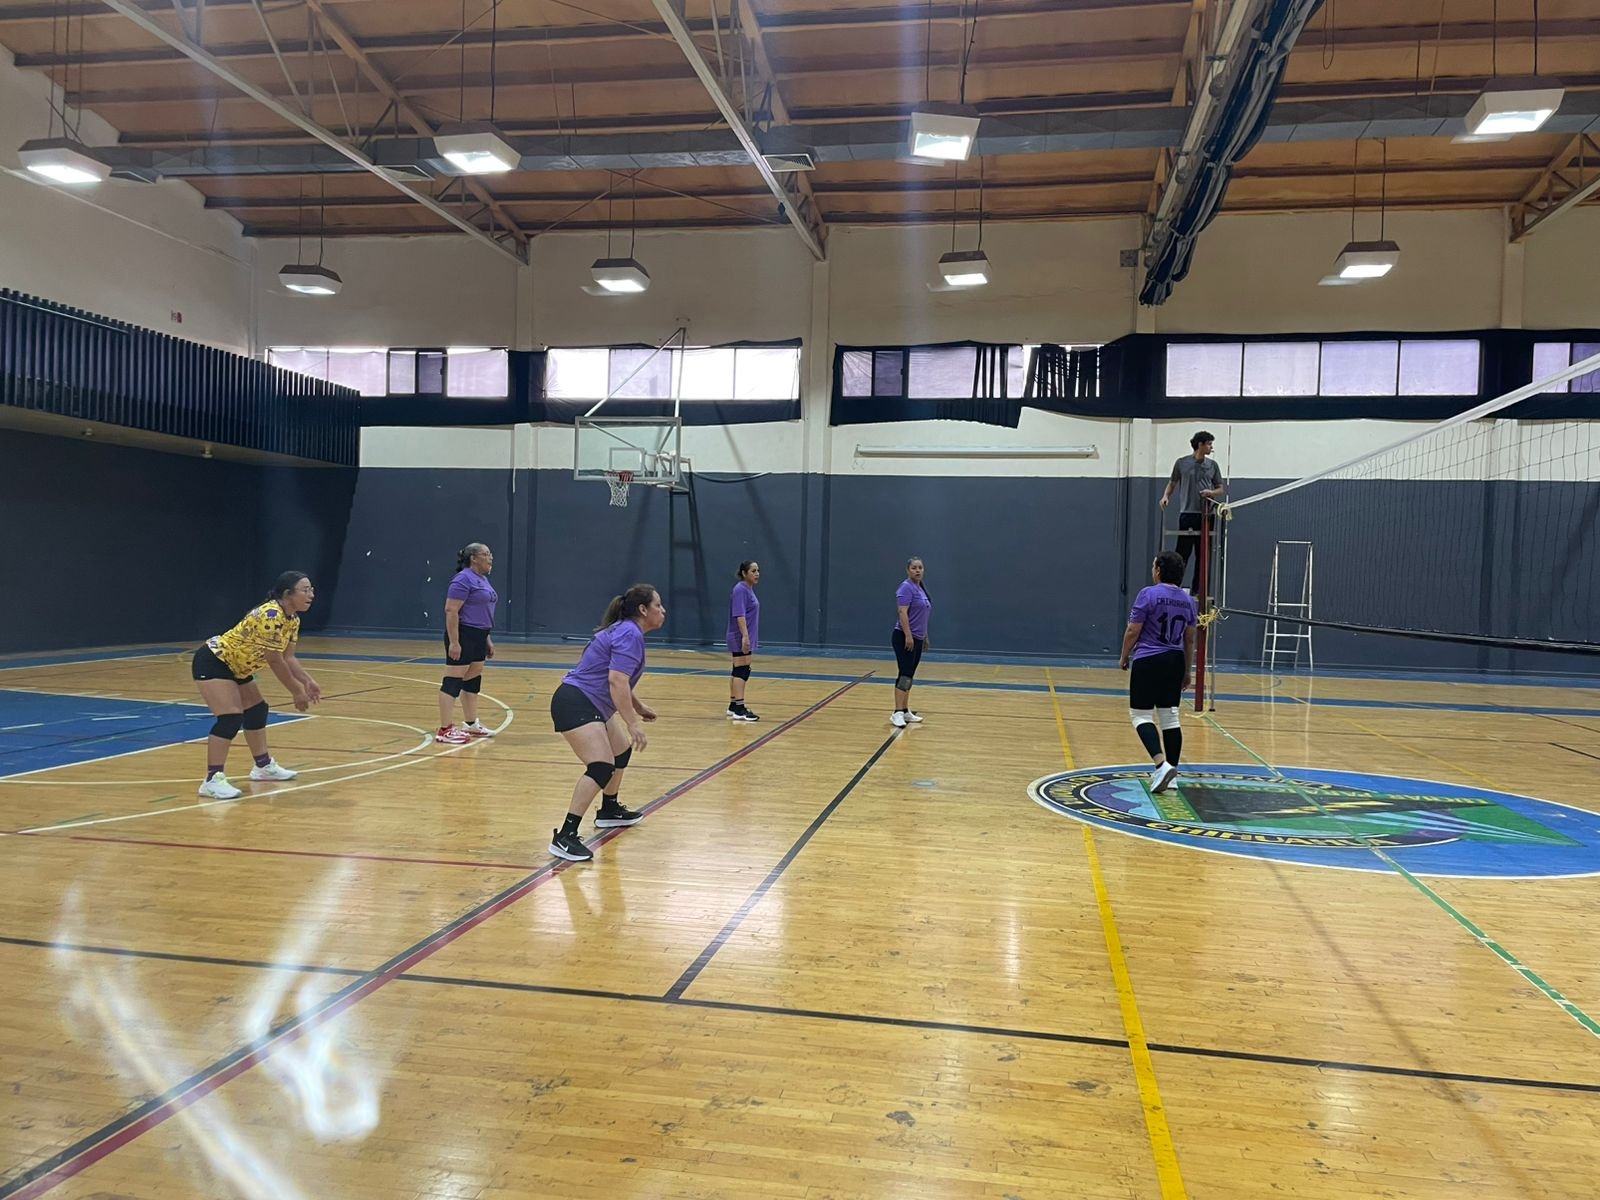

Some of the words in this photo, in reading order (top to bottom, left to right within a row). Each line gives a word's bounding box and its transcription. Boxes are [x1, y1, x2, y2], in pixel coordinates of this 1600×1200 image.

[1156, 612, 1187, 645] 10
[1080, 808, 1131, 820] DE
[1145, 822, 1403, 847] CHIHUAHUA
